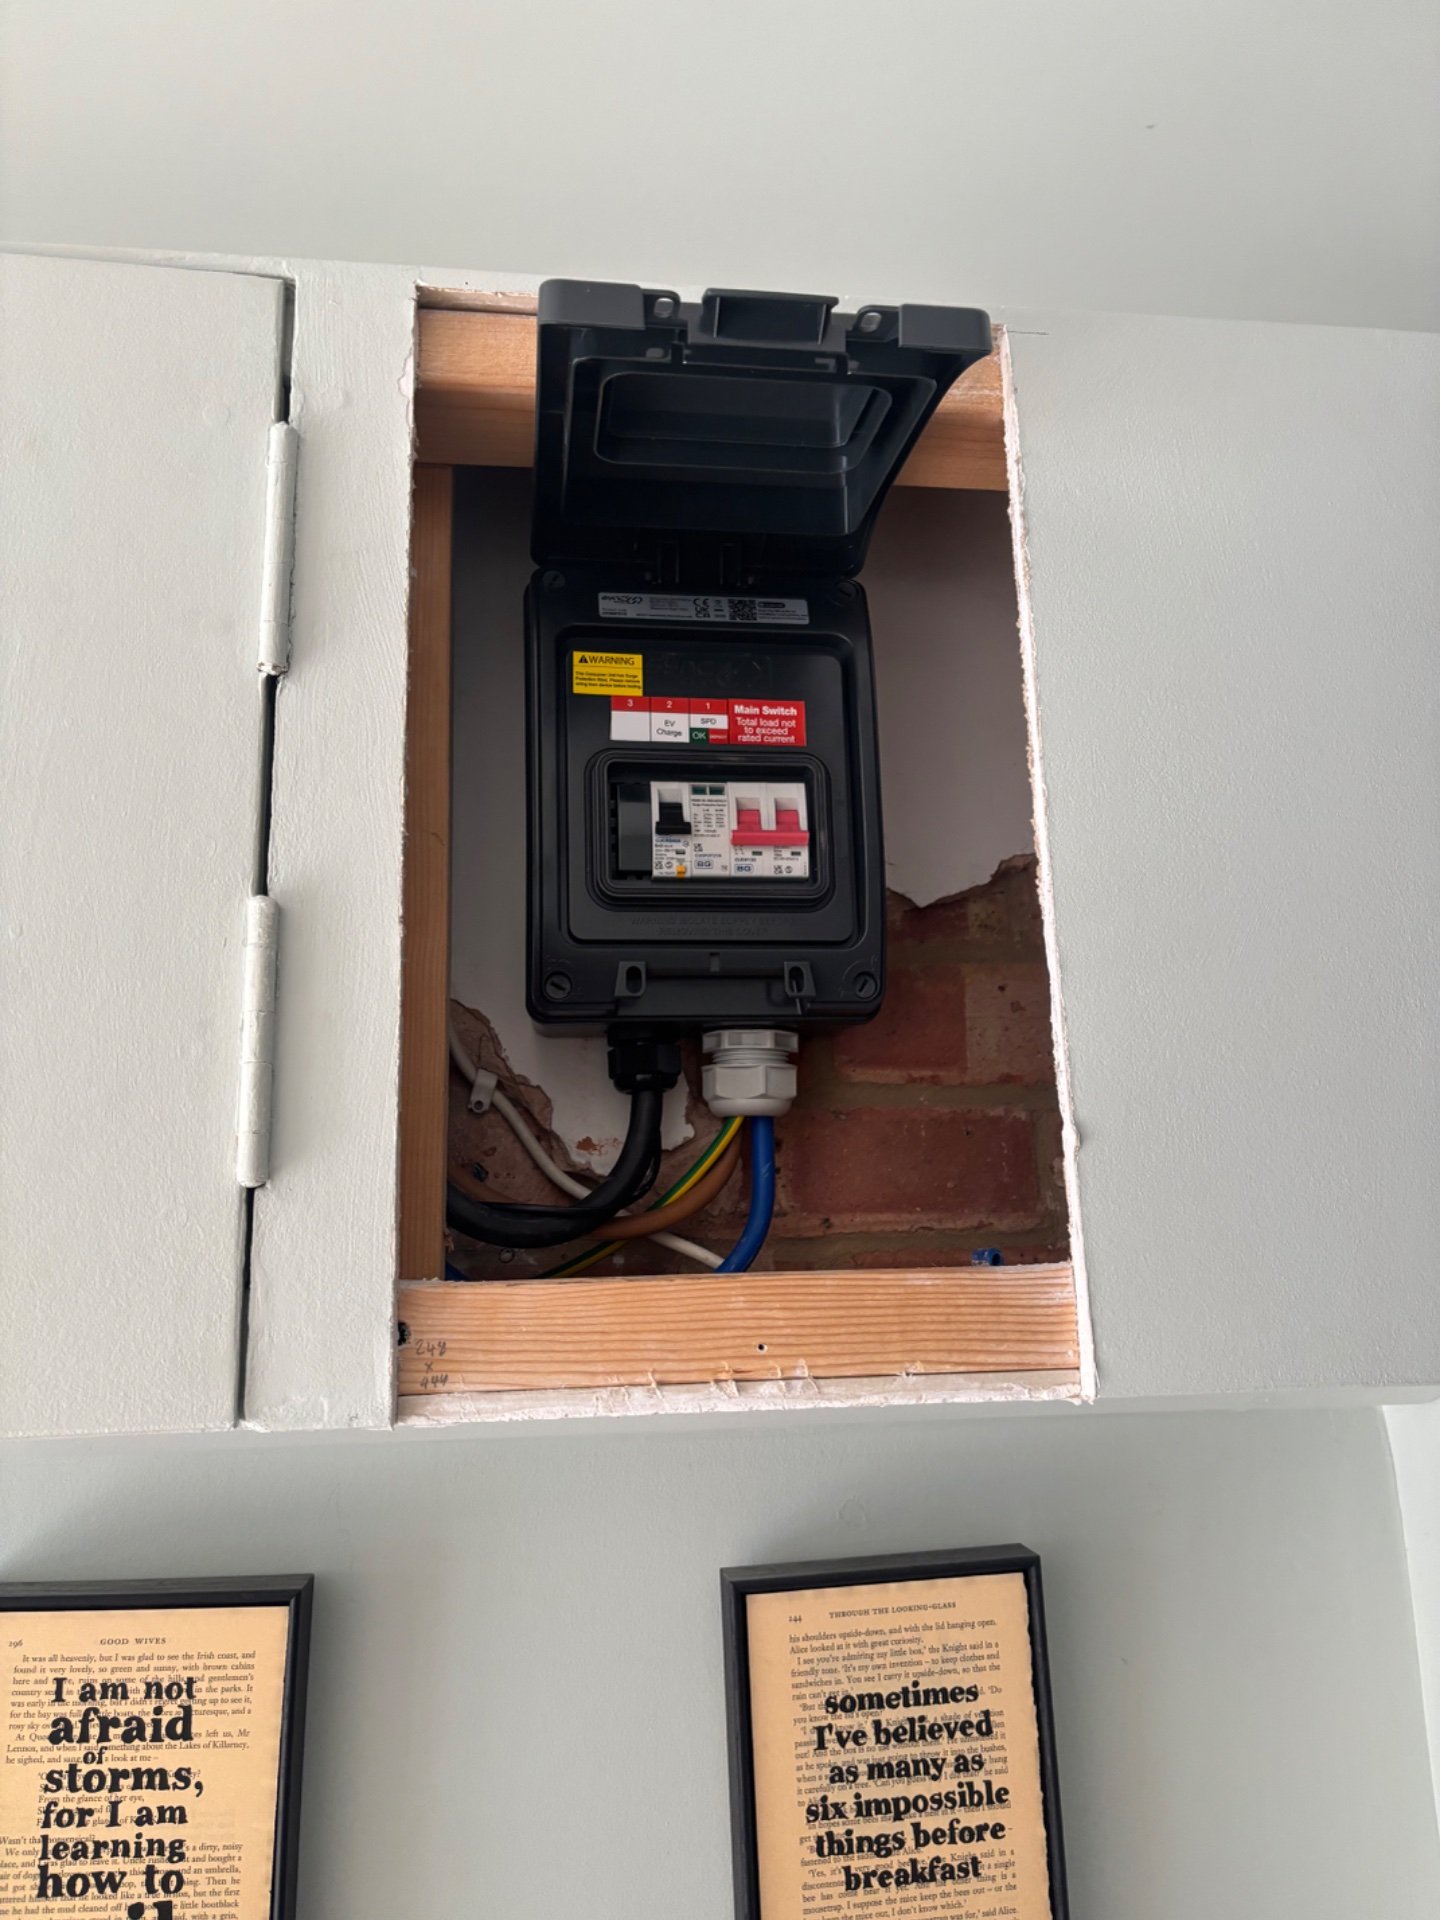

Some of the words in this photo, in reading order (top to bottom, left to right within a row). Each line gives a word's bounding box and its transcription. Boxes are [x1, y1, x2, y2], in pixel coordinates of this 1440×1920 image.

[588, 655, 635, 666] WARNING
[627, 699, 634, 707] 3
[734, 704, 760, 714] Main
[762, 706, 798, 716] Switch
[736, 717, 758, 726] Total
[760, 718, 780, 727] load
[781, 719, 796, 728] not
[756, 727, 788, 735] exceed
[656, 728, 683, 738] Charge
[692, 731, 706, 740] OK
[829, 1608, 870, 1619] THROUGH
[872, 1606, 890, 1615] THE
[892, 1602, 956, 1614] LOOKING-GLASS
[789, 1634, 800, 1643] his
[802, 1632, 837, 1642] shoulders
[838, 1628, 887, 1640] upside-down,
[889, 1626, 902, 1634] and
[904, 1625, 920, 1633] with
[922, 1623, 934, 1631] the
[936, 1621, 946, 1630] lid
[947, 1620, 976, 1630] hanging
[8, 1640, 23, 1648] 196
[790, 1646, 808, 1654] Alice
[810, 1642, 836, 1652] looked
[853, 1640, 869, 1648] with
[870, 1639, 890, 1650] great
[891, 1636, 924, 1647] curiosity.
[816, 1654, 840, 1666] you're
[842, 1651, 874, 1662] admiring
[876, 1652, 888, 1661] my
[890, 1648, 908, 1657] little
[928, 1645, 940, 1654] the
[942, 1643, 968, 1654] Knight
[970, 1640, 984, 1650] said
[985, 1640, 993, 1649] in
[22, 1654, 30, 1662] It
[48, 1654, 58, 1662] all
[60, 1654, 96, 1664] heavenly,
[100, 1654, 112, 1662] but
[115, 1653, 120, 1661] I
[137, 1652, 154, 1663] glad
[156, 1653, 165, 1661] to
[182, 1652, 194, 1660] the
[197, 1651, 214, 1660] Irish
[218, 1652, 239, 1660] coast,
[242, 1650, 256, 1659] and
[14, 1665, 37, 1674] found
[40, 1666, 46, 1674] it
[70, 1665, 95, 1674] lovely,
[110, 1666, 133, 1675] green
[136, 1664, 150, 1672] and
[153, 1665, 179, 1674] sunny,
[182, 1663, 200, 1671] with
[202, 1662, 228, 1671] brown
[231, 1662, 255, 1670] cabins
[51, 1677, 68, 1702] I
[79, 1682, 130, 1702] am
[144, 1676, 196, 1700] not
[824, 1680, 980, 1714] sometimes
[48, 1706, 194, 1745] afraid
[814, 1722, 868, 1751] I've
[872, 1709, 994, 1746] believed
[6, 1744, 38, 1754] Lennox,
[40, 1744, 54, 1752] and
[56, 1743, 77, 1752] when
[78, 1744, 82, 1752] I
[142, 1742, 163, 1750] about
[165, 1741, 178, 1750] the
[180, 1741, 201, 1750] Lakes
[203, 1740, 212, 1750] of
[83, 1746, 108, 1764] of
[829, 1765, 859, 1784] as
[866, 1758, 948, 1782] many
[954, 1754, 984, 1774] as
[44, 1763, 204, 1798] storms,
[806, 1794, 849, 1824] six
[854, 1780, 1010, 1822] impossible
[40, 1800, 94, 1828] for
[105, 1800, 122, 1828] I
[134, 1805, 188, 1828] am
[38, 1832, 187, 1864] learning
[816, 1828, 906, 1858] things
[910, 1818, 1006, 1850] before
[37, 1864, 128, 1898] how
[144, 1864, 184, 1894] to
[842, 1856, 982, 1892] breakfast
[846, 1901, 851, 1910] I
[853, 1901, 883, 1911] suppose
[885, 1896, 897, 1906] the
[900, 1896, 918, 1904] mice
[920, 1892, 938, 1903] keep
[940, 1890, 952, 1899] the
[954, 1888, 970, 1897] bees
[972, 1886, 986, 1895] out
[1006, 1882, 1017, 1891] the
[897, 1906, 916, 1916] don't
[918, 1904, 938, 1914] know
